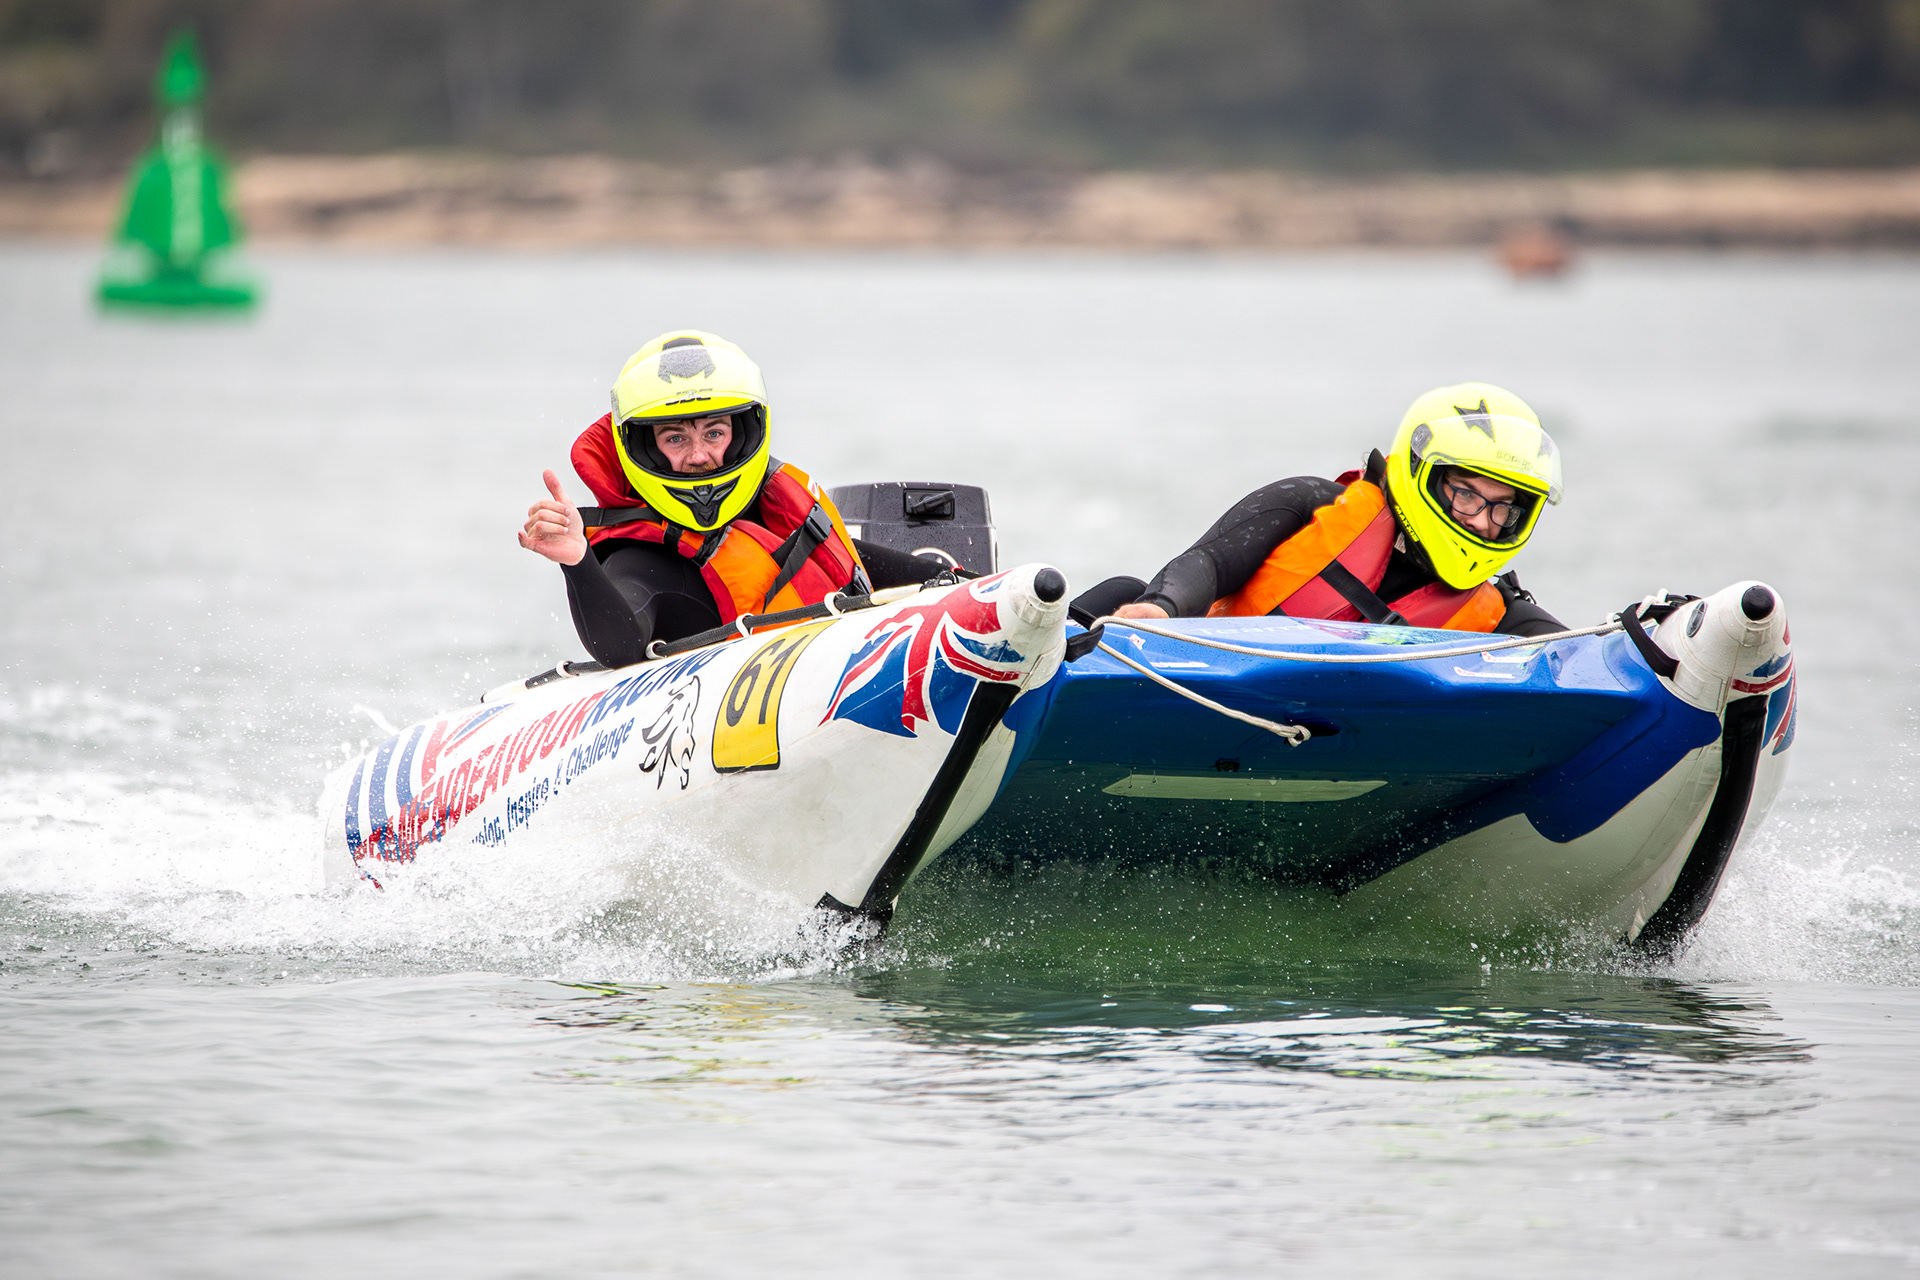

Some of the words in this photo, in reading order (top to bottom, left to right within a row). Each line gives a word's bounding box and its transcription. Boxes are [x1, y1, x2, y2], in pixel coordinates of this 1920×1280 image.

[725, 637, 811, 728] 61
[506, 776, 550, 831] Inspire
[566, 716, 636, 786] Challenge
